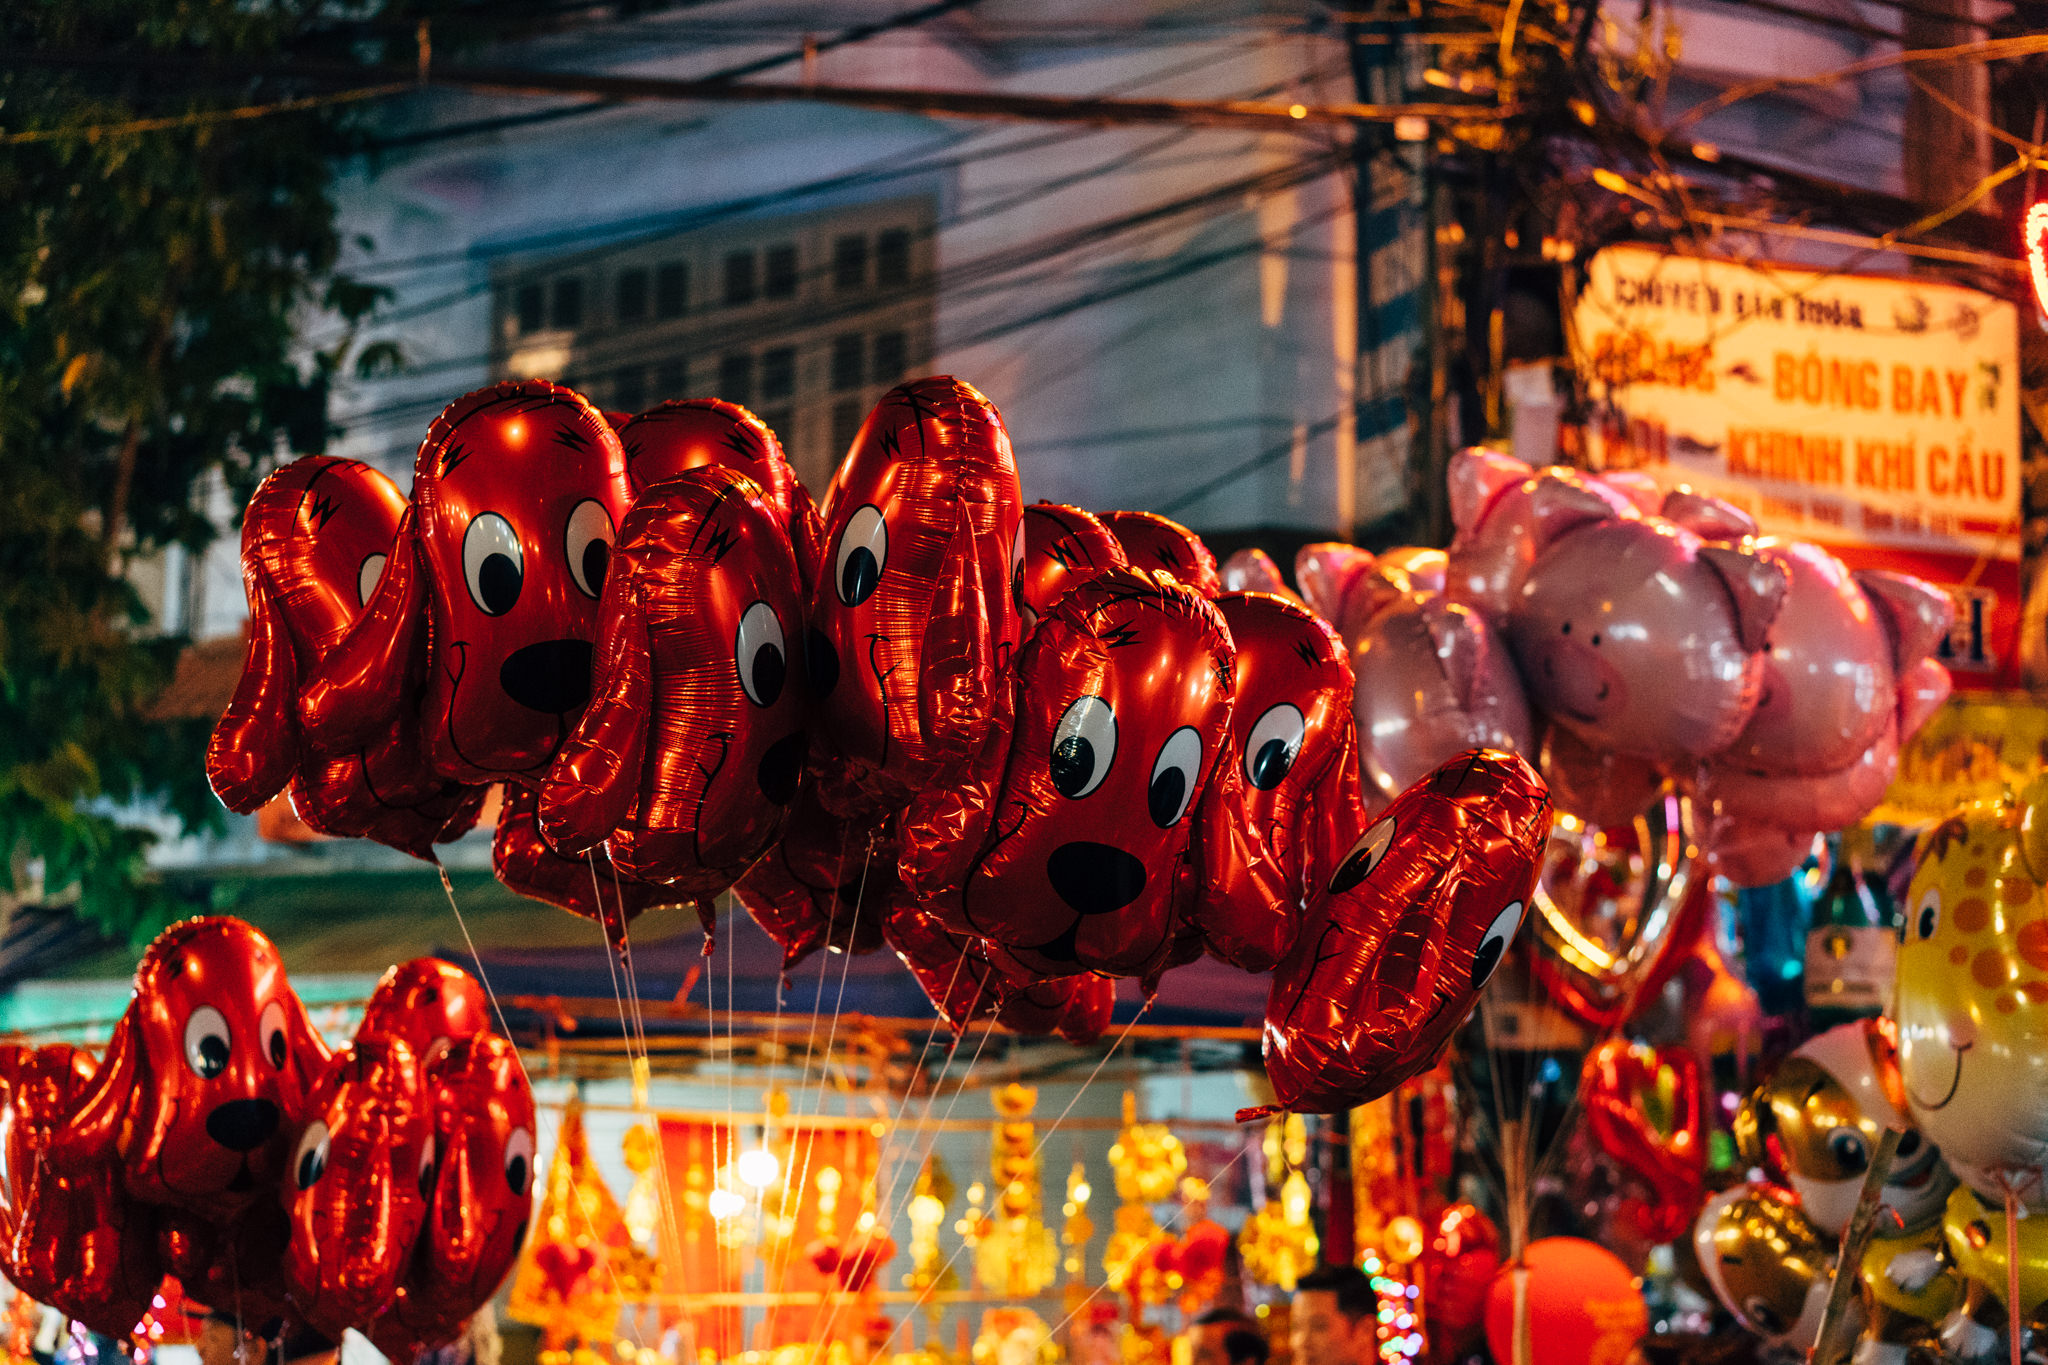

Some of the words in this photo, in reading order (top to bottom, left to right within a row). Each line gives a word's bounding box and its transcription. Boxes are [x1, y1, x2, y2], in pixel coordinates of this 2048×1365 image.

[1772, 343, 1880, 412] BÓNG
[1892, 364, 1968, 418] BAY
[1727, 428, 1843, 485] KHINH
[1855, 432, 1917, 492] KHÍ
